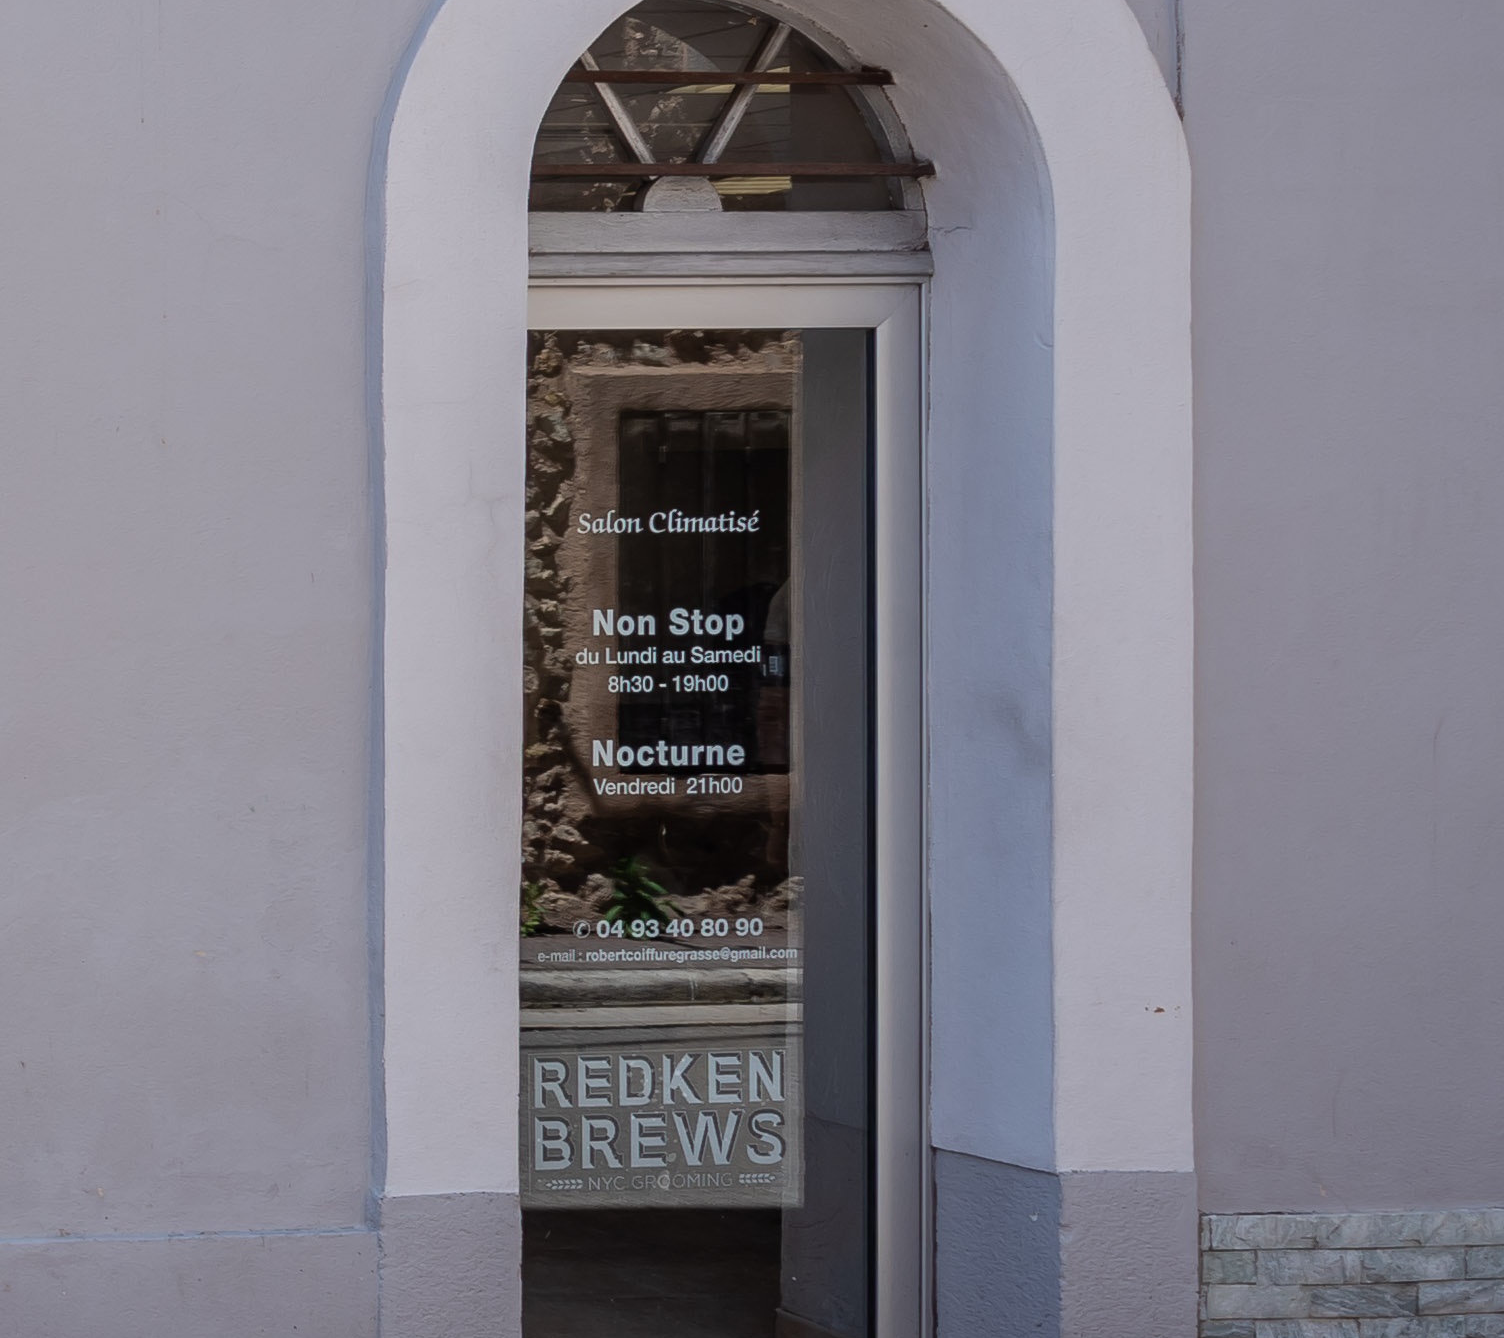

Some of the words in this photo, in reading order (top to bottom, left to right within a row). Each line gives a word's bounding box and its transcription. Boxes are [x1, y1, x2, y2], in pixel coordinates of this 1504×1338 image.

[576, 510, 644, 534] Salon
[648, 509, 761, 534] Climatisé
[592, 609, 656, 636] Non
[668, 608, 745, 641] Stop
[575, 649, 600, 664] du
[605, 647, 657, 664] Lundi
[662, 650, 685, 664] au
[690, 646, 762, 664] Samedi
[608, 675, 654, 693] 8h30
[671, 675, 729, 692] 19h00
[592, 740, 746, 767] Nocturne
[593, 777, 676, 795] Vendredi
[686, 777, 743, 794] 21h00
[596, 919, 625, 938] 04
[631, 919, 660, 938] 93
[665, 919, 694, 937] 40
[700, 918, 728, 937] 80
[734, 918, 764, 936] 90
[537, 949, 576, 962] e-mail
[585, 947, 798, 964] robertcoiffuregrasse@gmail.com
[534, 1050, 786, 1109] REDKEN
[534, 1109, 786, 1171] BREWS
[587, 1176, 626, 1192] NYC
[631, 1173, 734, 1191] GROOMING
